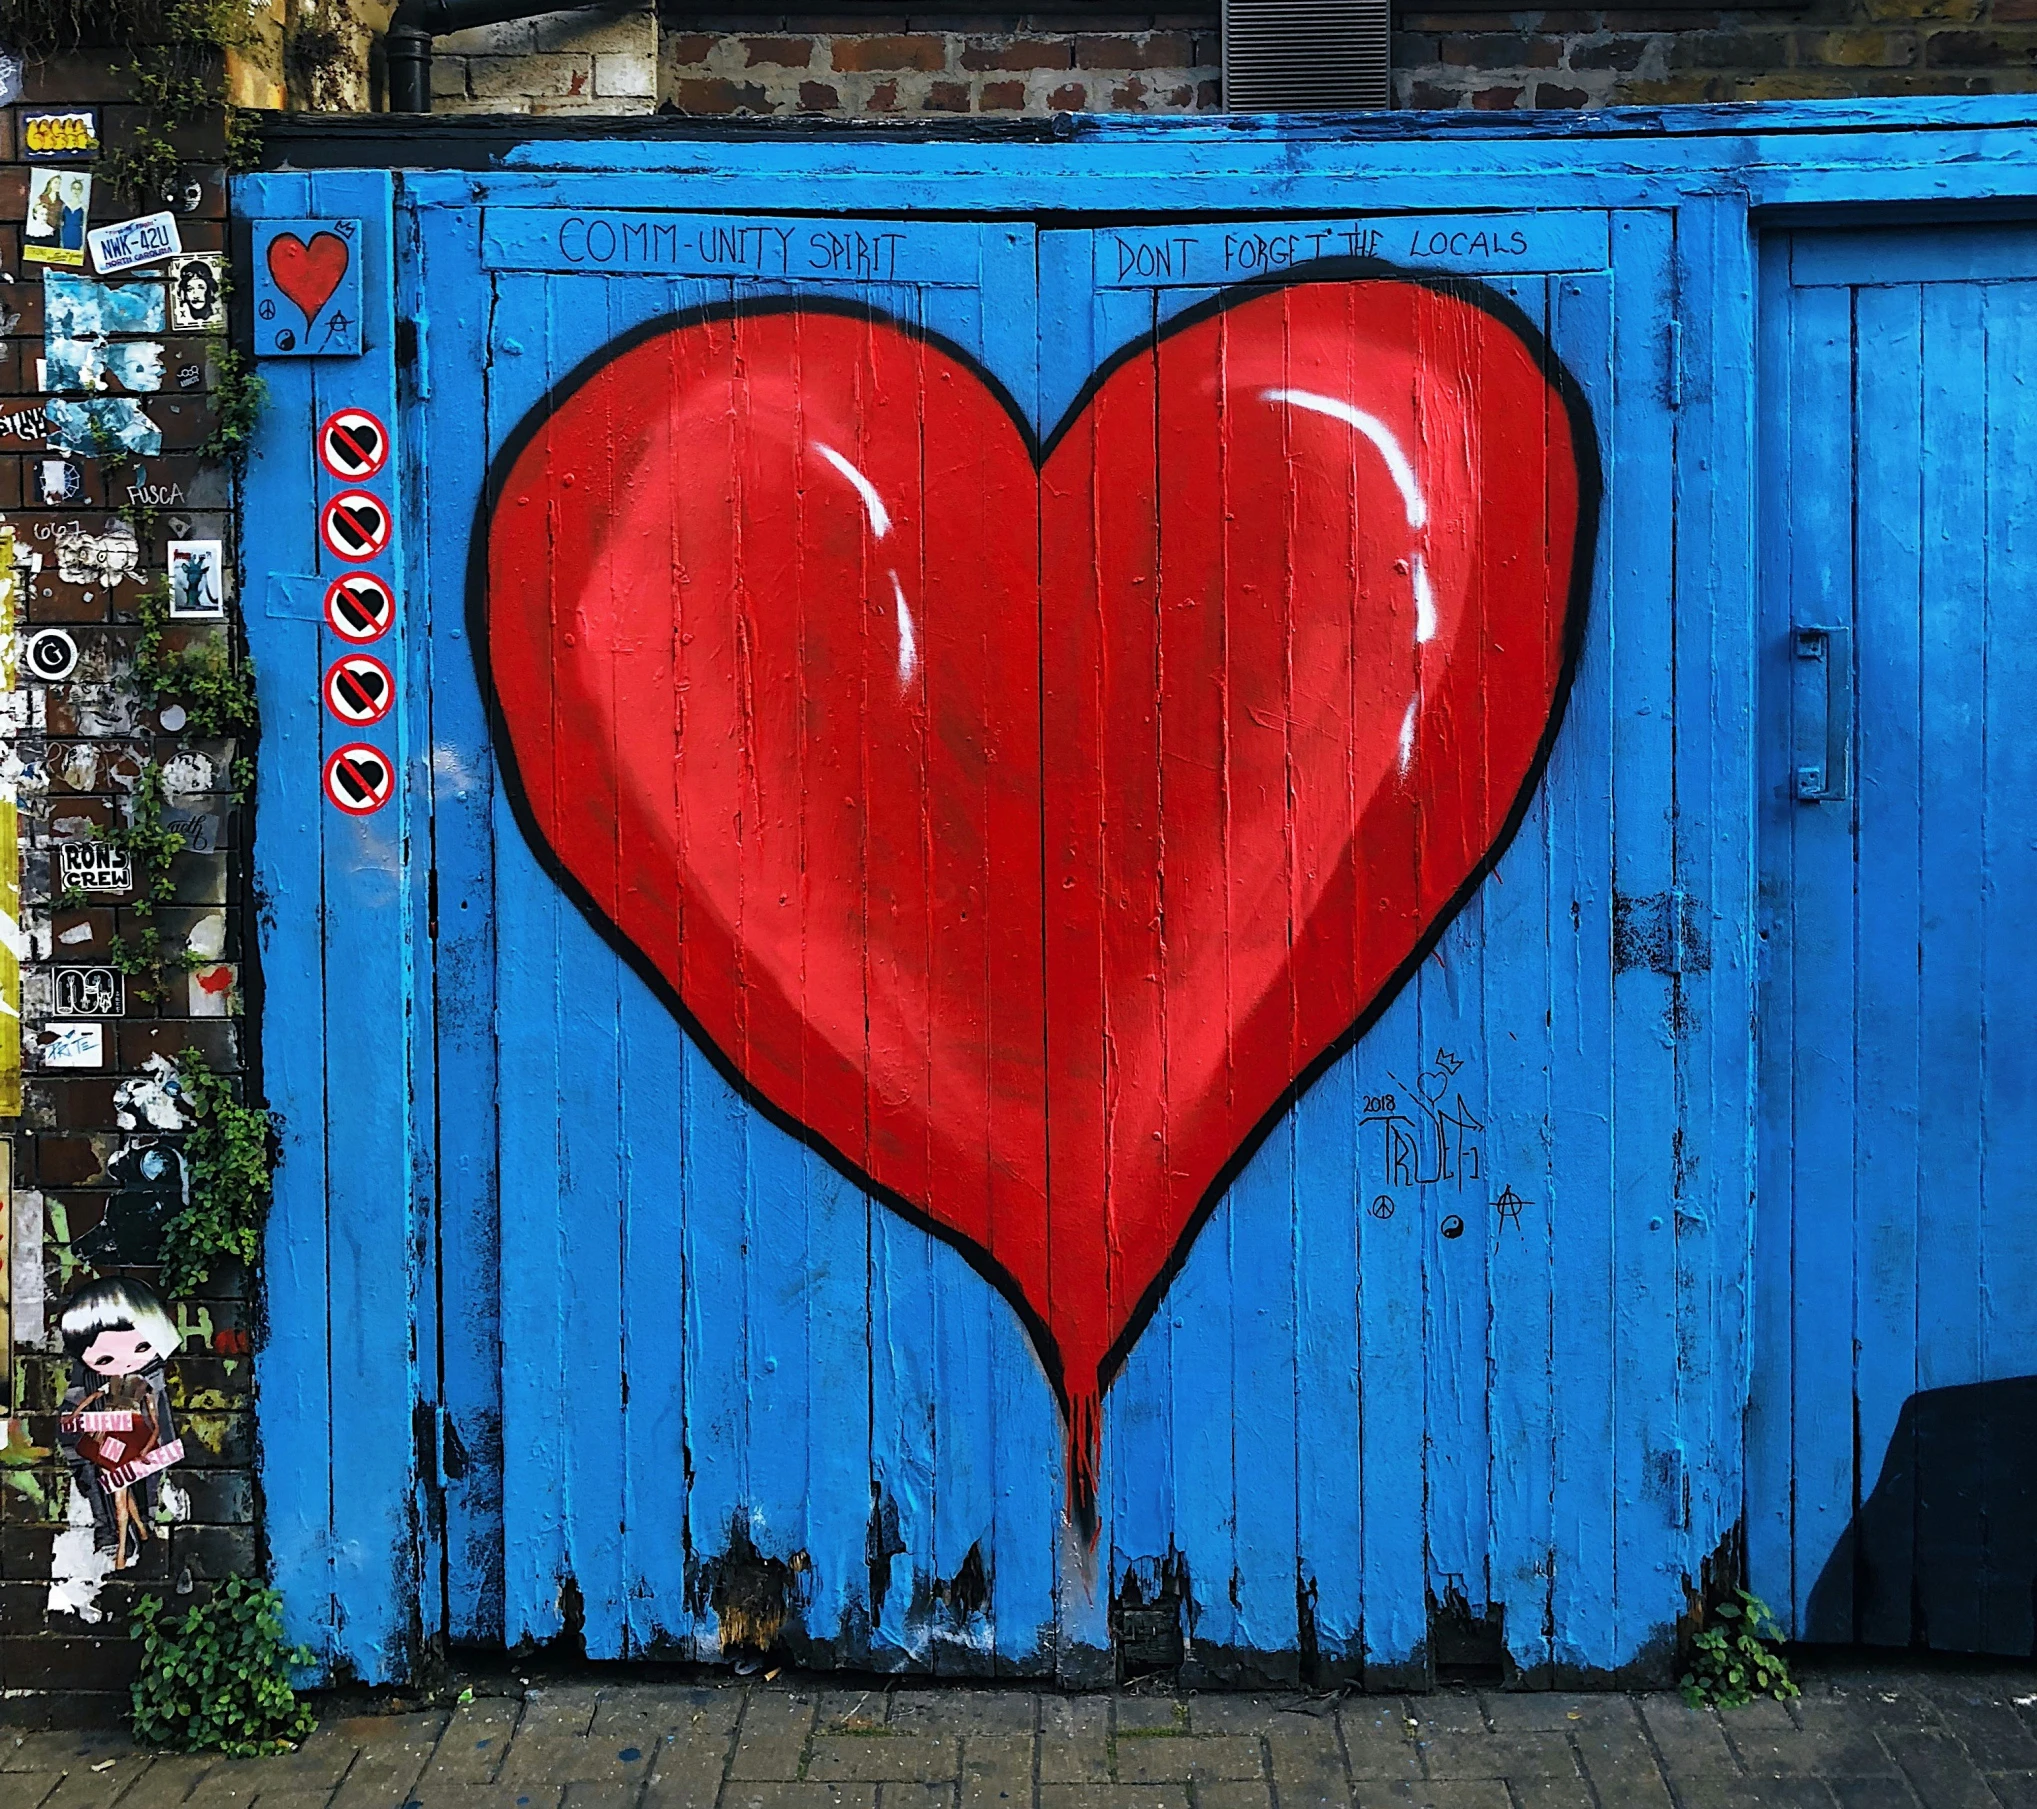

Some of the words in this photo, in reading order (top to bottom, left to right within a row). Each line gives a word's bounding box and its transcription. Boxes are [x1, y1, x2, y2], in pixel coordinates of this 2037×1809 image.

[105, 255, 133, 268] NORTH
[134, 246, 173, 262] CAROLINA
[559, 217, 796, 275] COMM-UNITY
[808, 230, 907, 282] SPIRIT
[1116, 236, 1199, 283] DONT
[1224, 232, 1328, 274] FORGET
[1338, 222, 1384, 258] THE
[1409, 230, 1529, 258] LOCALS
[126, 482, 185, 505] FUSCA
[41, 642, 64, 665] G
[66, 870, 128, 887] CREW
[1362, 1095, 1397, 1114] 2018
[101, 1437, 125, 1461] IN
[99, 1439, 185, 1494] YOUSELF
